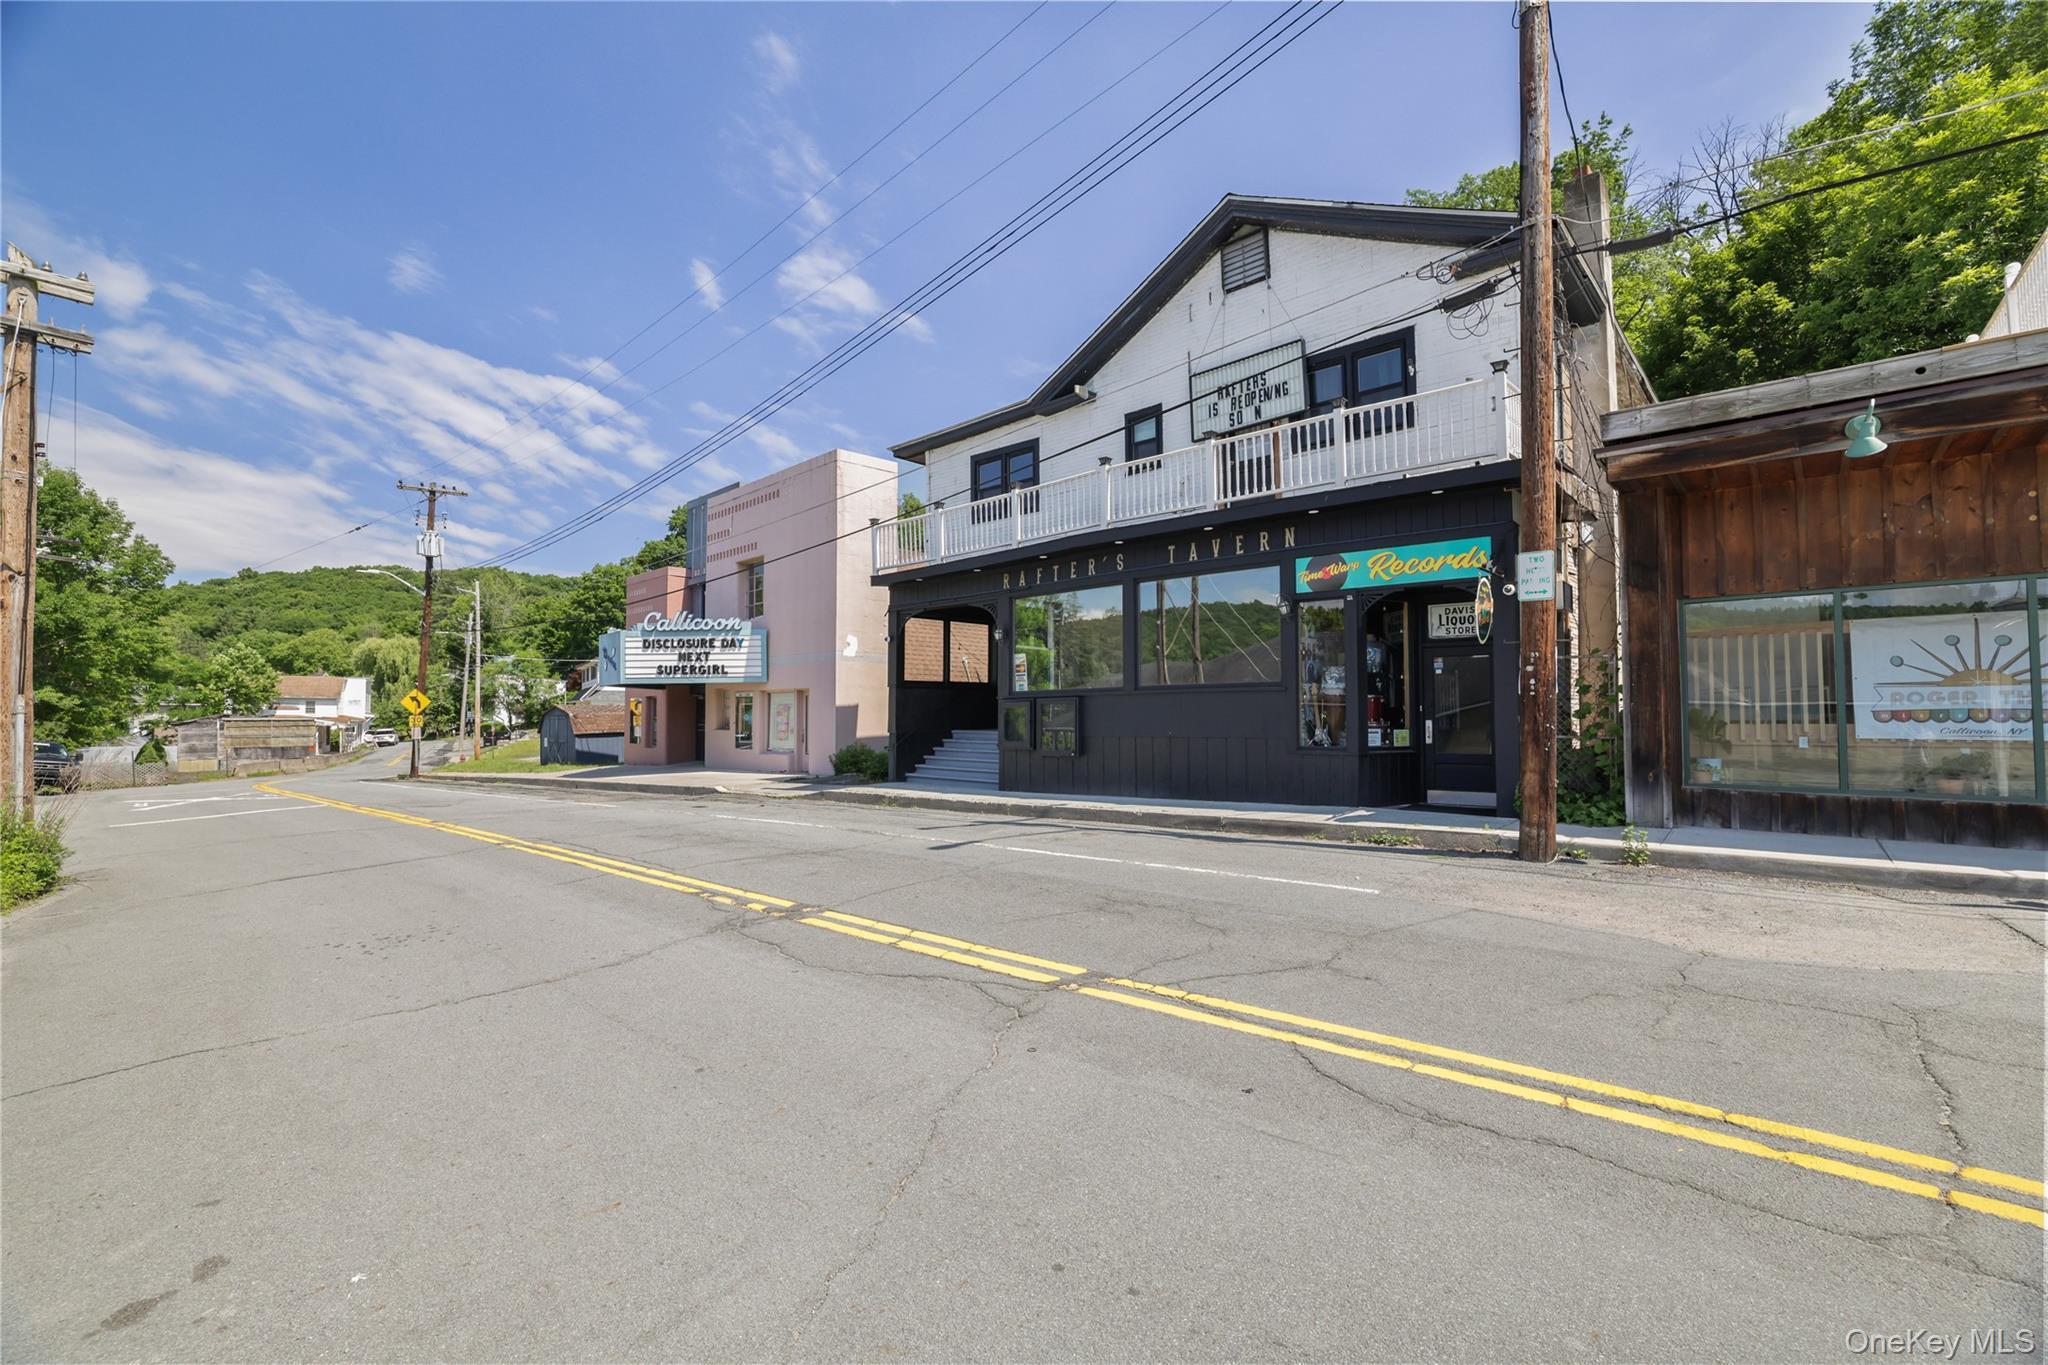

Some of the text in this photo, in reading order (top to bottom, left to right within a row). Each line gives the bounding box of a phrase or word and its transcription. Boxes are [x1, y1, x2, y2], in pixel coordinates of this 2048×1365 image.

[1208, 403, 1219, 419] IS
[1002, 527, 1297, 590] RAFTER'S TAVERN
[1297, 545, 1490, 585] Time Warp Records
[1444, 606, 1475, 616] DAVIS
[643, 610, 743, 632] Callicoon
[1438, 614, 1476, 627] LIQUO
[1445, 626, 1477, 635] STORE
[642, 637, 745, 650] DISCLOSURE DAY
[677, 651, 711, 663] NEXT
[656, 664, 729, 676] SUPERGIRL
[1889, 689, 1979, 706] ROGER
